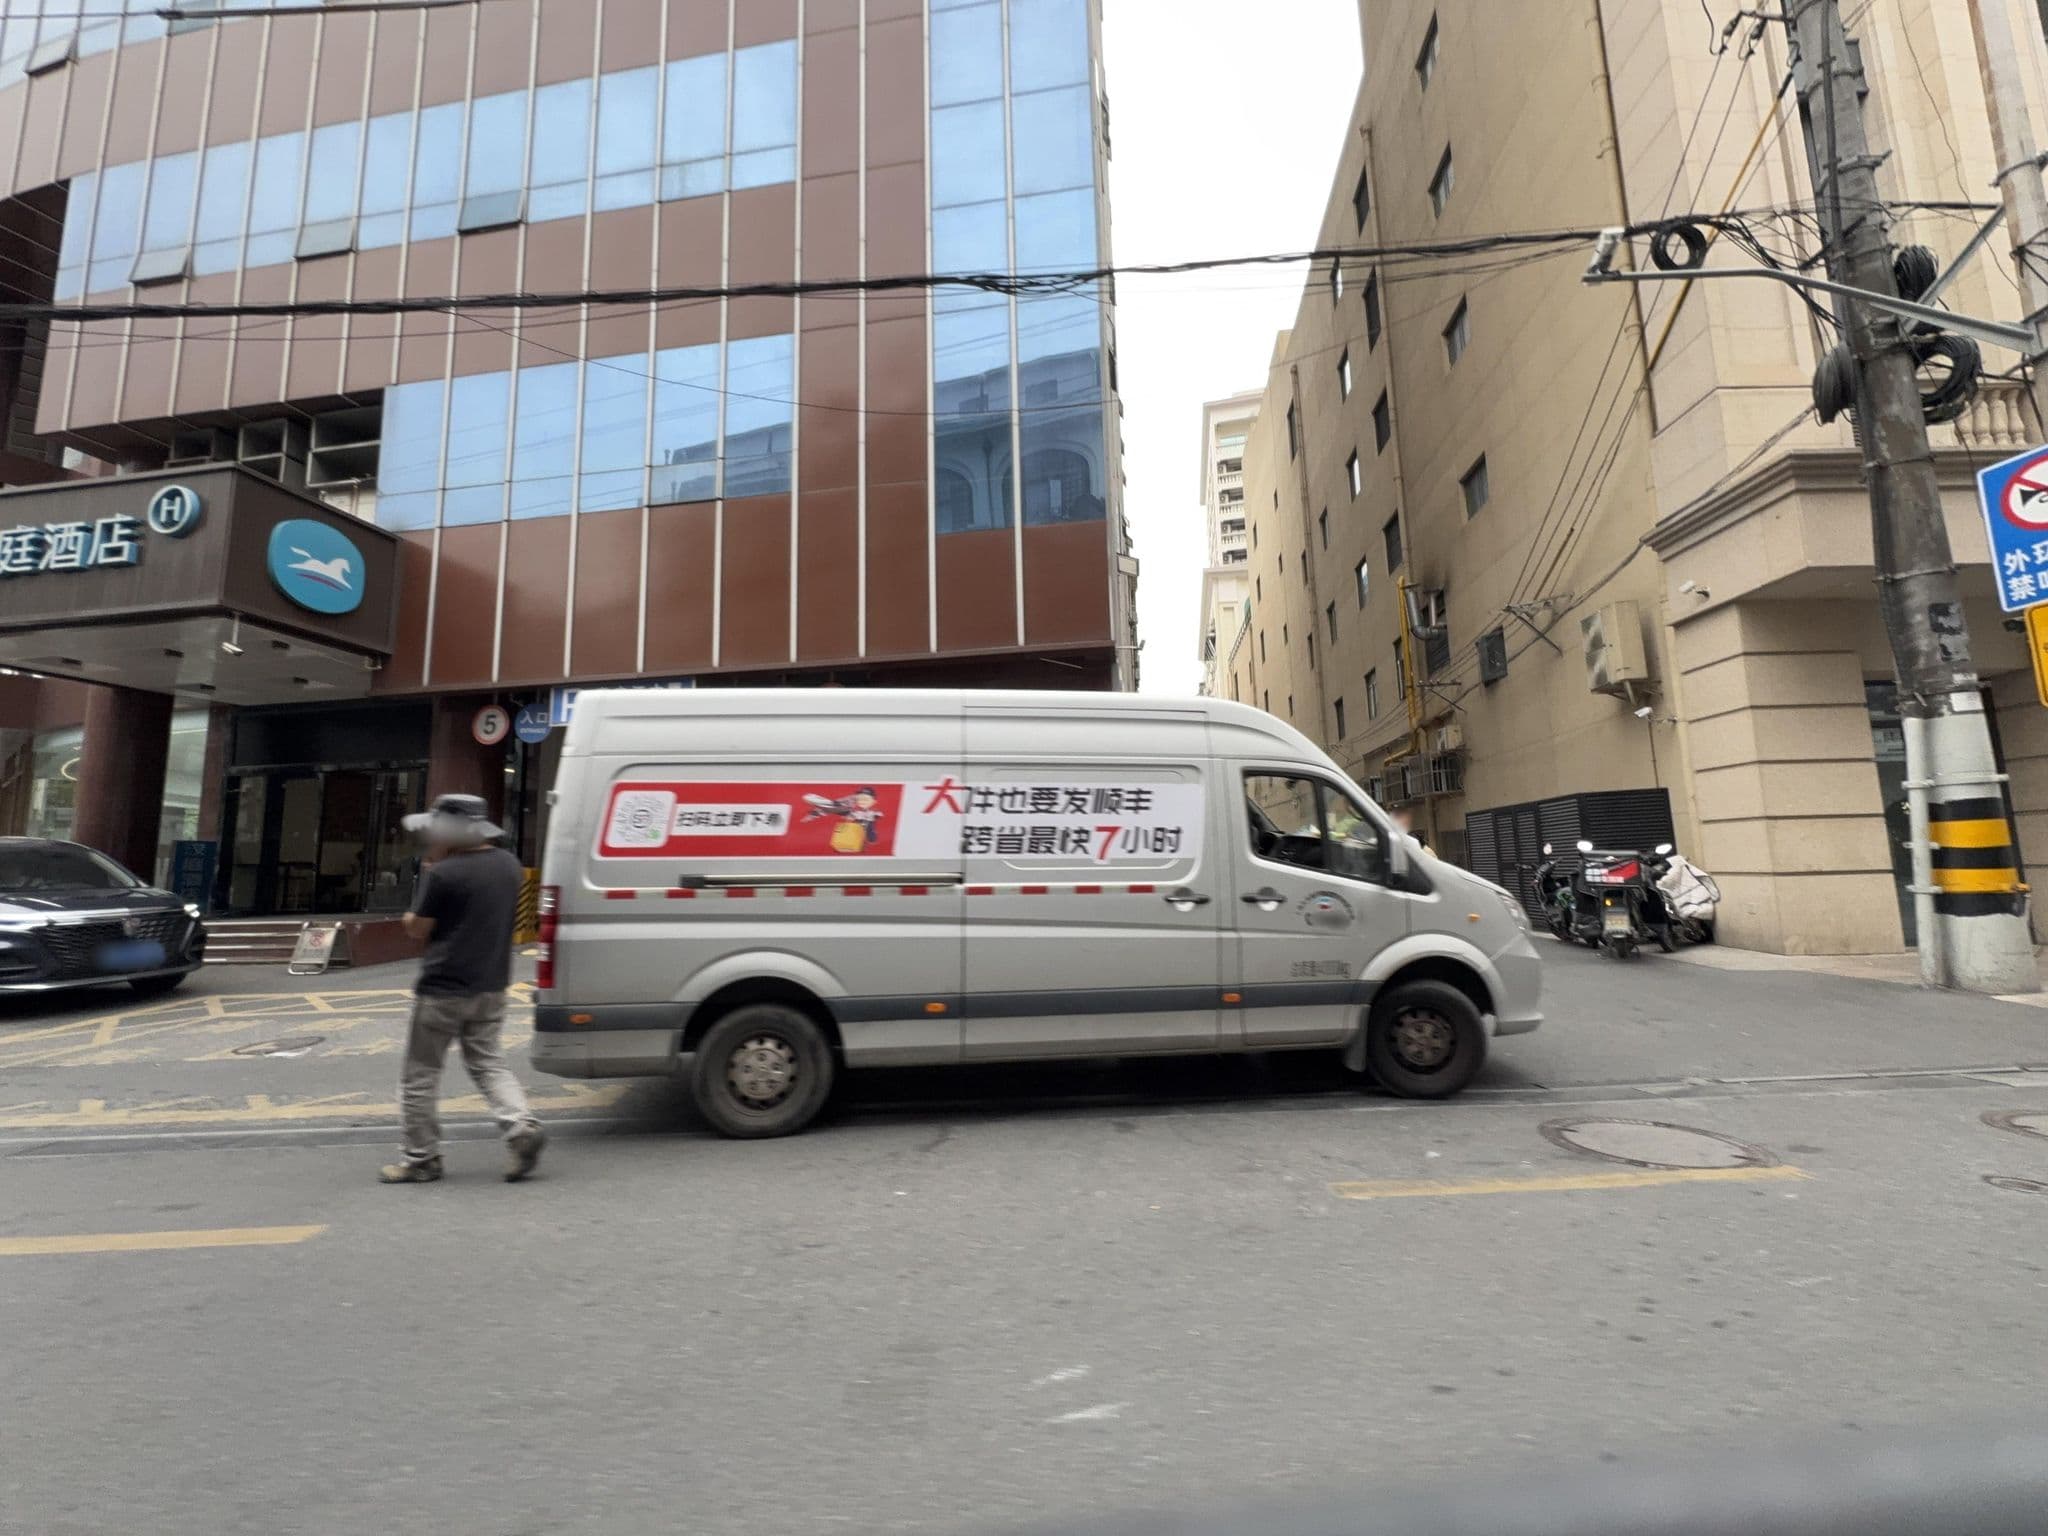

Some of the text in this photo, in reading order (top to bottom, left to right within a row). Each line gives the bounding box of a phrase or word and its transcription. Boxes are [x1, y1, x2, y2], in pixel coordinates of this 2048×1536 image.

[0, 513, 138, 575] 庭酒店
[484, 714, 498, 735] 5
[520, 710, 548, 724] 入口
[960, 825, 1181, 860] 跨省最快7小时
